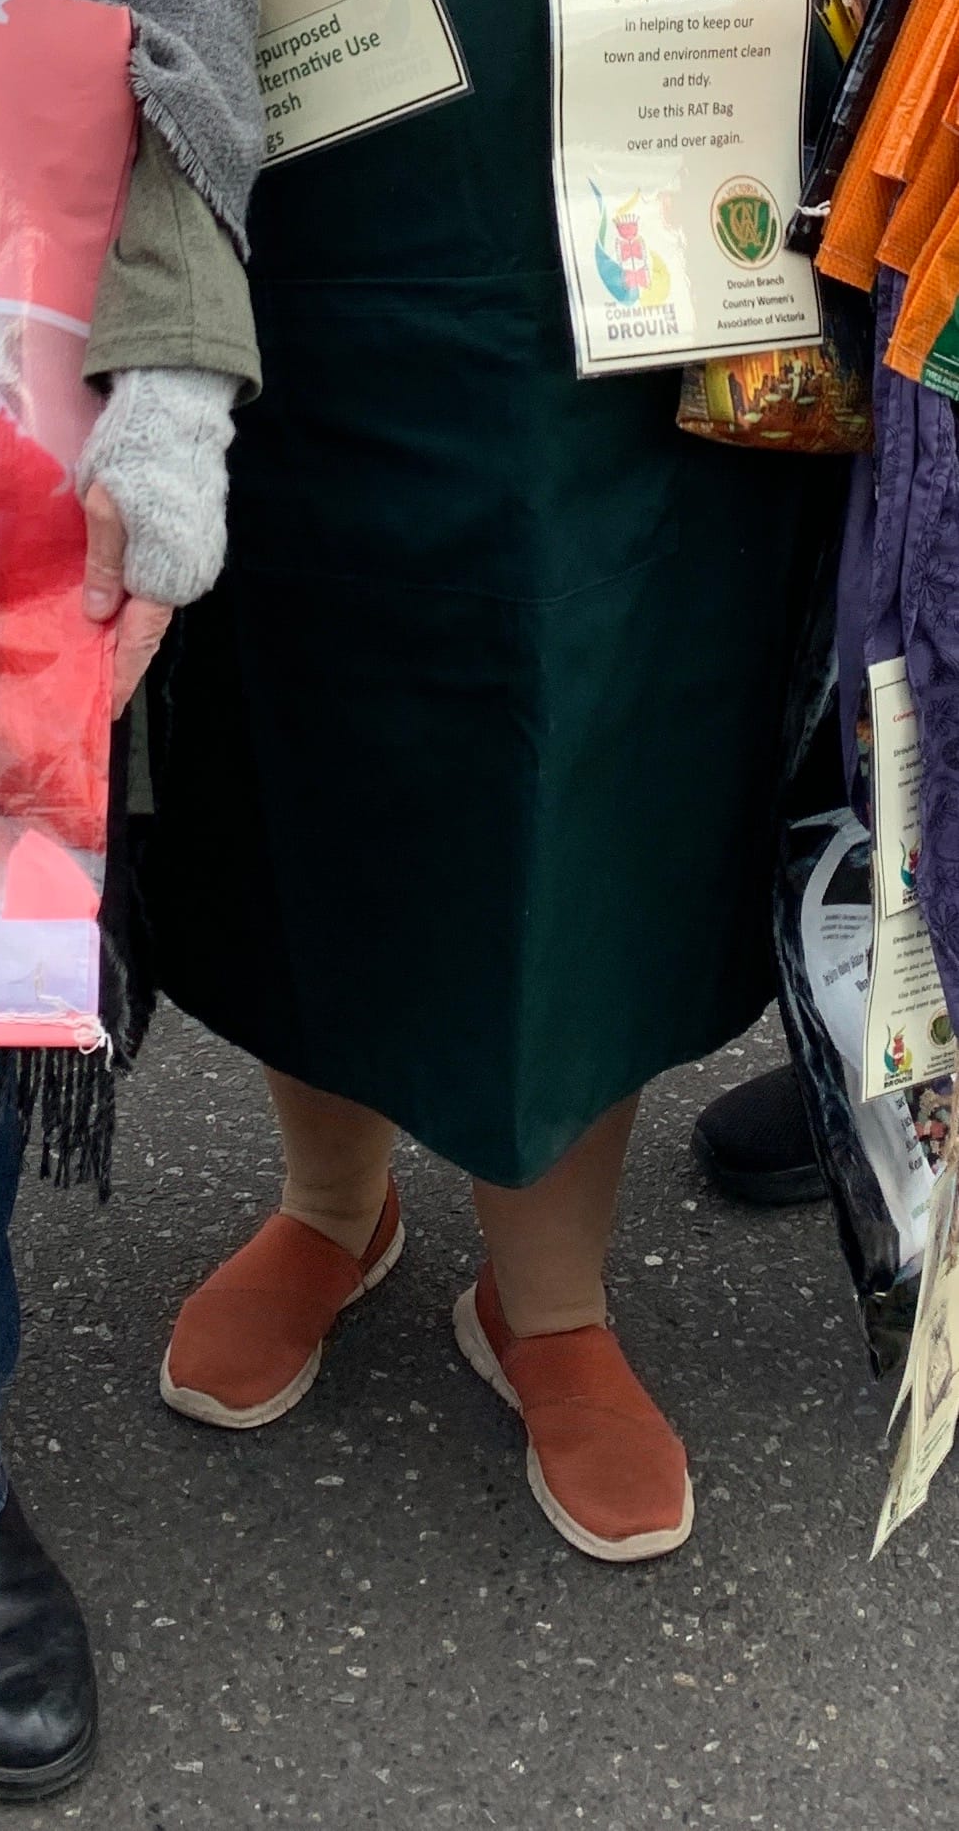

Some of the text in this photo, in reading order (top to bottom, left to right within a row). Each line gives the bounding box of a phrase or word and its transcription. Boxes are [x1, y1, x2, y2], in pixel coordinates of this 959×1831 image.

[625, 16, 754, 34] in helping to keep our
[259, 48, 343, 95] lternative
[345, 31, 381, 56] Use
[604, 44, 771, 64] town and environment clean
[662, 72, 712, 88] and tidy.
[265, 93, 302, 121] rash
[638, 102, 734, 119] Use this RAT Bag
[266, 130, 285, 153] gs
[627, 138, 653, 151] over
[656, 134, 678, 149] and
[681, 135, 707, 148] over
[727, 275, 785, 290] Drouin Branch
[722, 294, 794, 310] Country Women's
[607, 319, 679, 340] DROUIN
[717, 311, 805, 330] Association of Victoria
